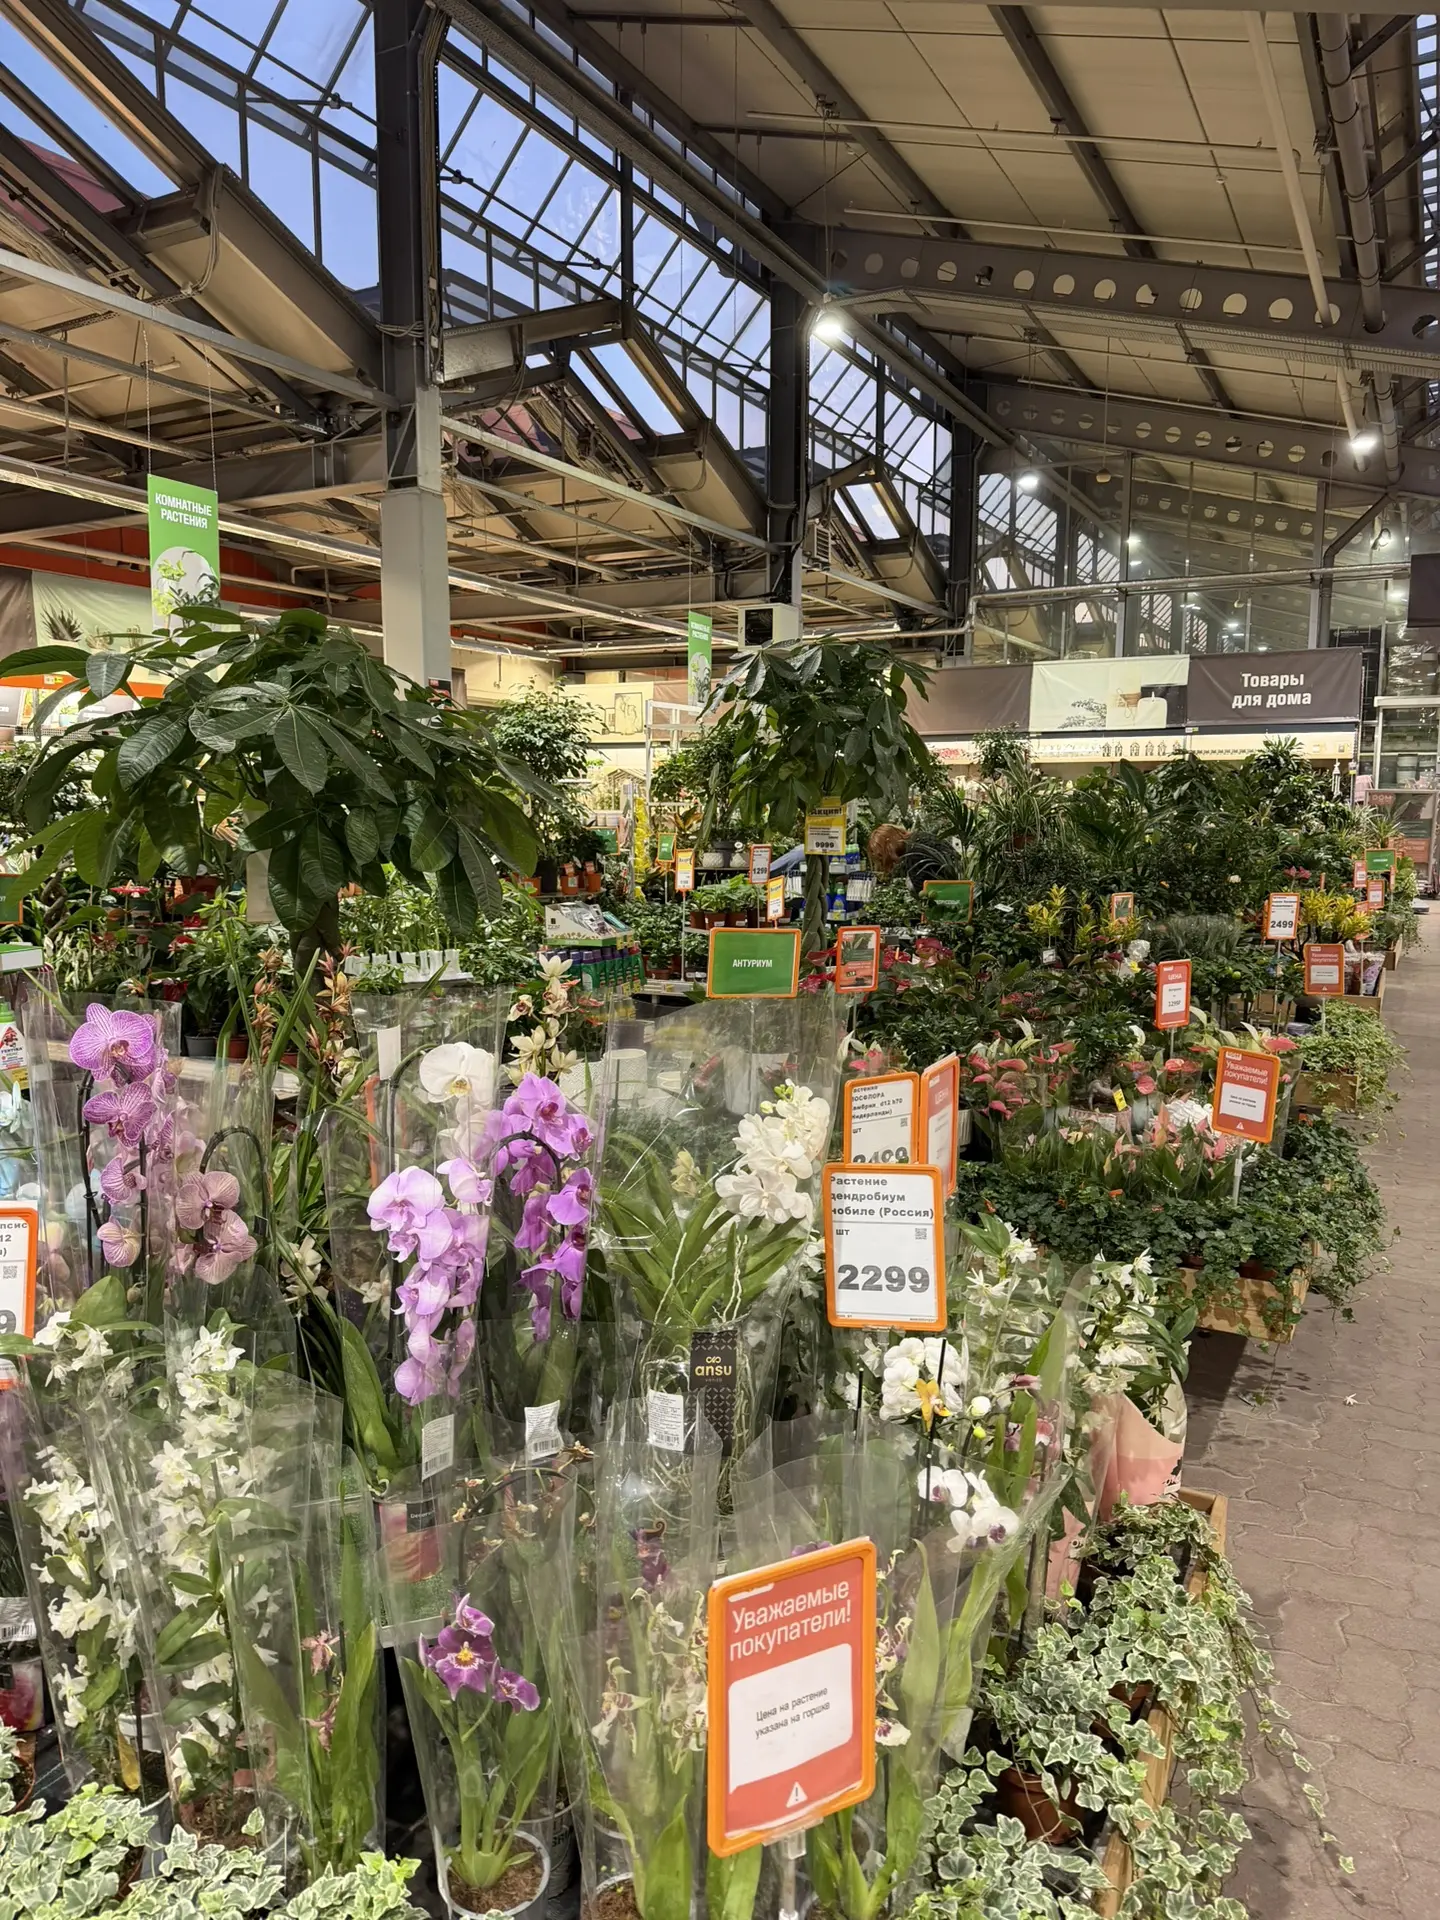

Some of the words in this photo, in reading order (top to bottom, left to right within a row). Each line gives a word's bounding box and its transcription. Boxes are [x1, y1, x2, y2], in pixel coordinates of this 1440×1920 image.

[155, 492, 212, 516] КОМНАТНЫЕ
[161, 508, 208, 529] РАСТЕНИЯ
[1241, 673, 1304, 690] Товары
[1231, 694, 1262, 709] для
[1266, 692, 1312, 708] дома
[1270, 920, 1294, 929] 2499
[732, 959, 773, 968] АНТУРИУМ
[879, 1207, 934, 1220] (Россия)
[836, 1228, 850, 1236] шт
[837, 1264, 930, 1293] 2299
[694, 1365, 732, 1376] ansu
[732, 1581, 849, 1634] Уважаемые
[730, 1599, 851, 1662] покупатели!
[756, 1707, 777, 1722] Цена
[779, 1702, 790, 1712] на
[791, 1687, 828, 1710] растение
[755, 1719, 789, 1740] указана
[790, 1714, 801, 1724] на
